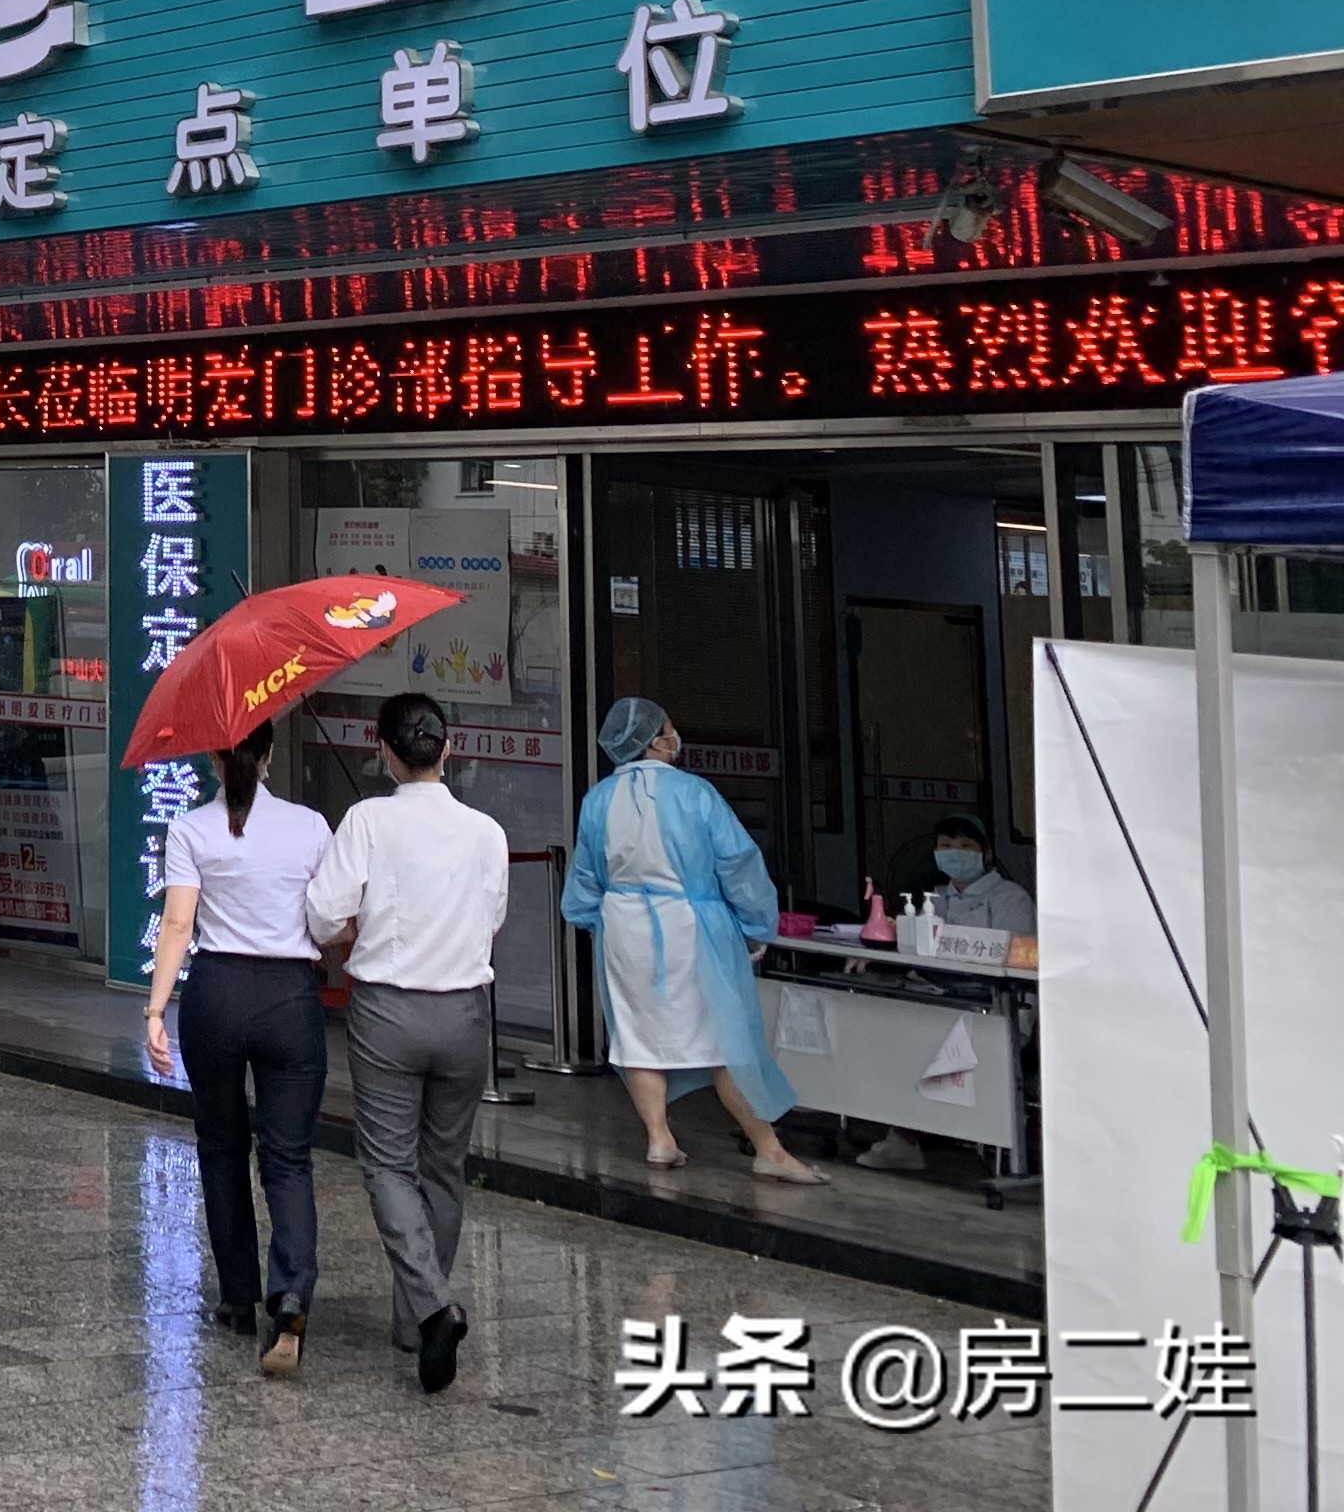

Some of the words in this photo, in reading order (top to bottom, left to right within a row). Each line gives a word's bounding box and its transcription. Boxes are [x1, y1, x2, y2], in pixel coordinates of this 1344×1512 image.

[242, 656, 307, 712] MCK
[936, 935, 1006, 959] 预检分诊
